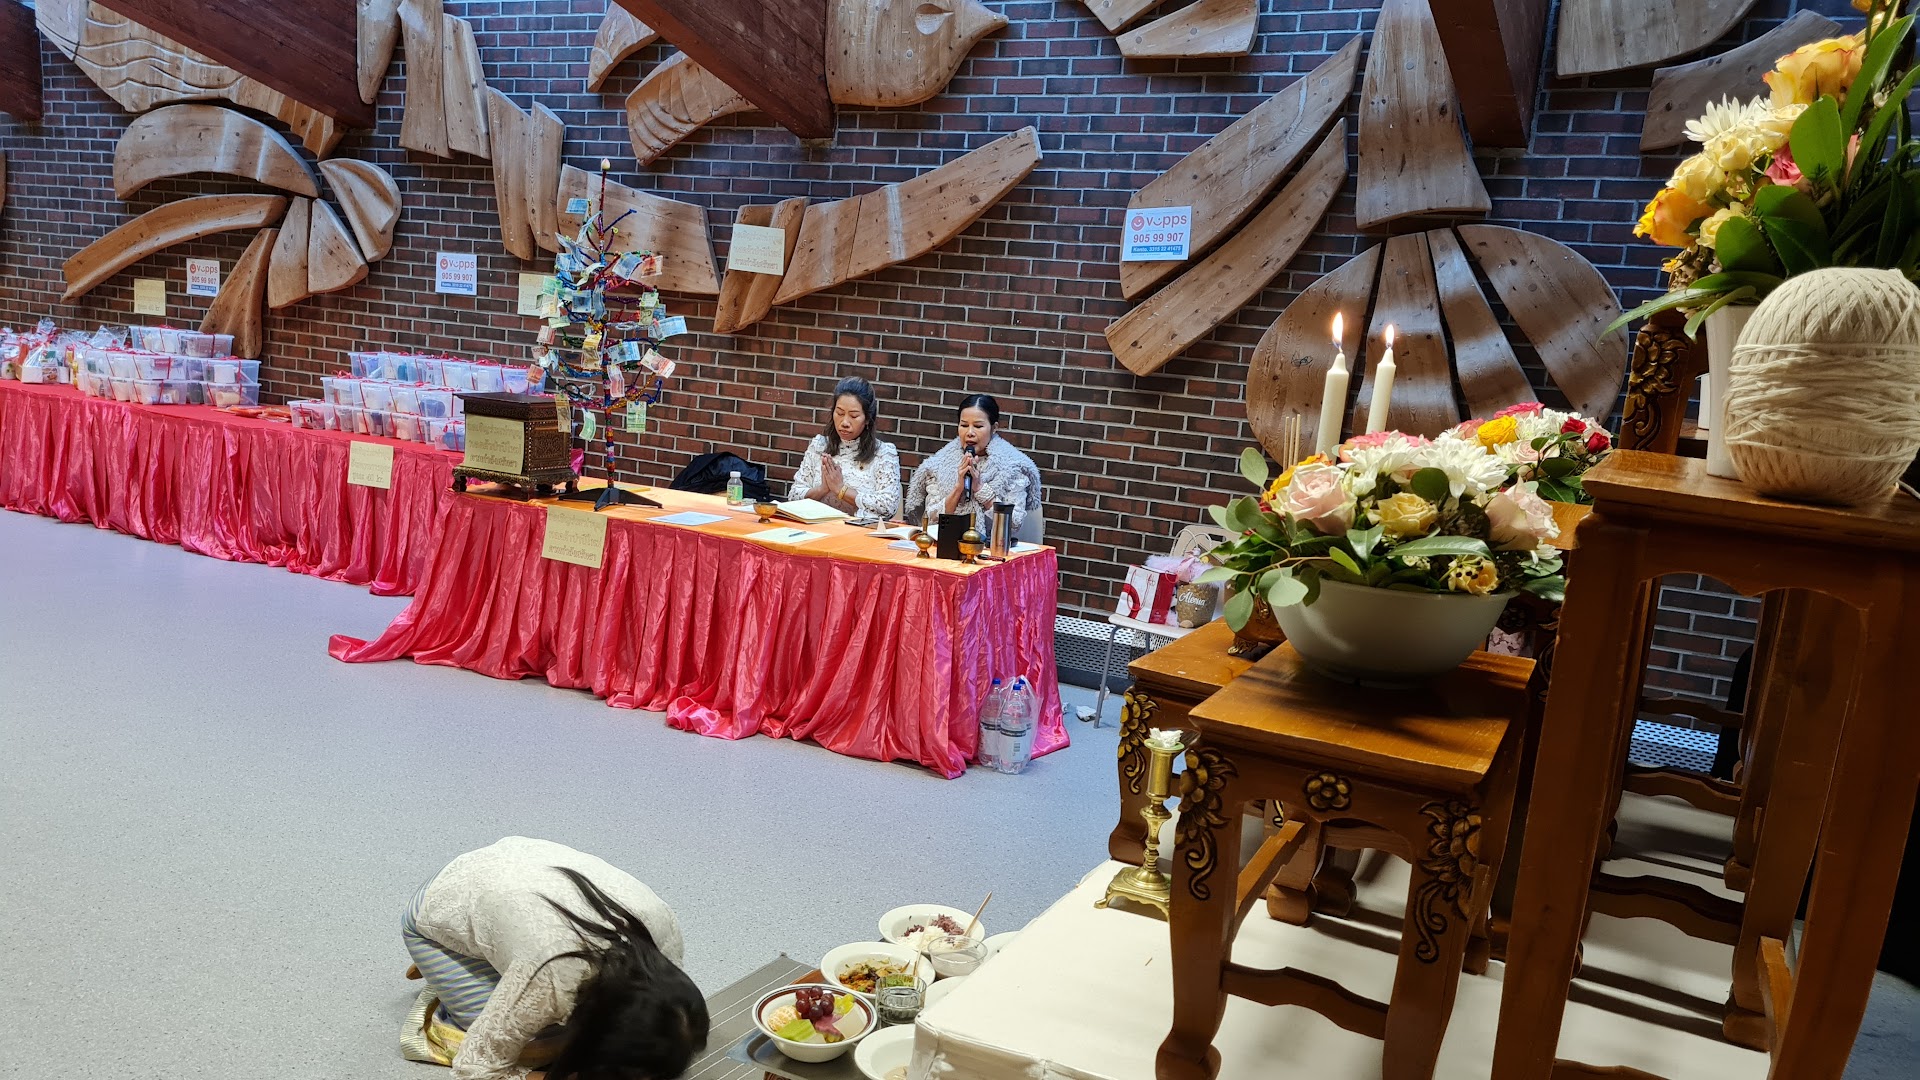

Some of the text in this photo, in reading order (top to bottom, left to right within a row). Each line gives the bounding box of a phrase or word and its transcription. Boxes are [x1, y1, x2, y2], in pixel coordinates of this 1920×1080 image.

[1133, 232, 1184, 243] 905 99 907
[441, 272, 452, 280] 905
[462, 273, 472, 281] 907
